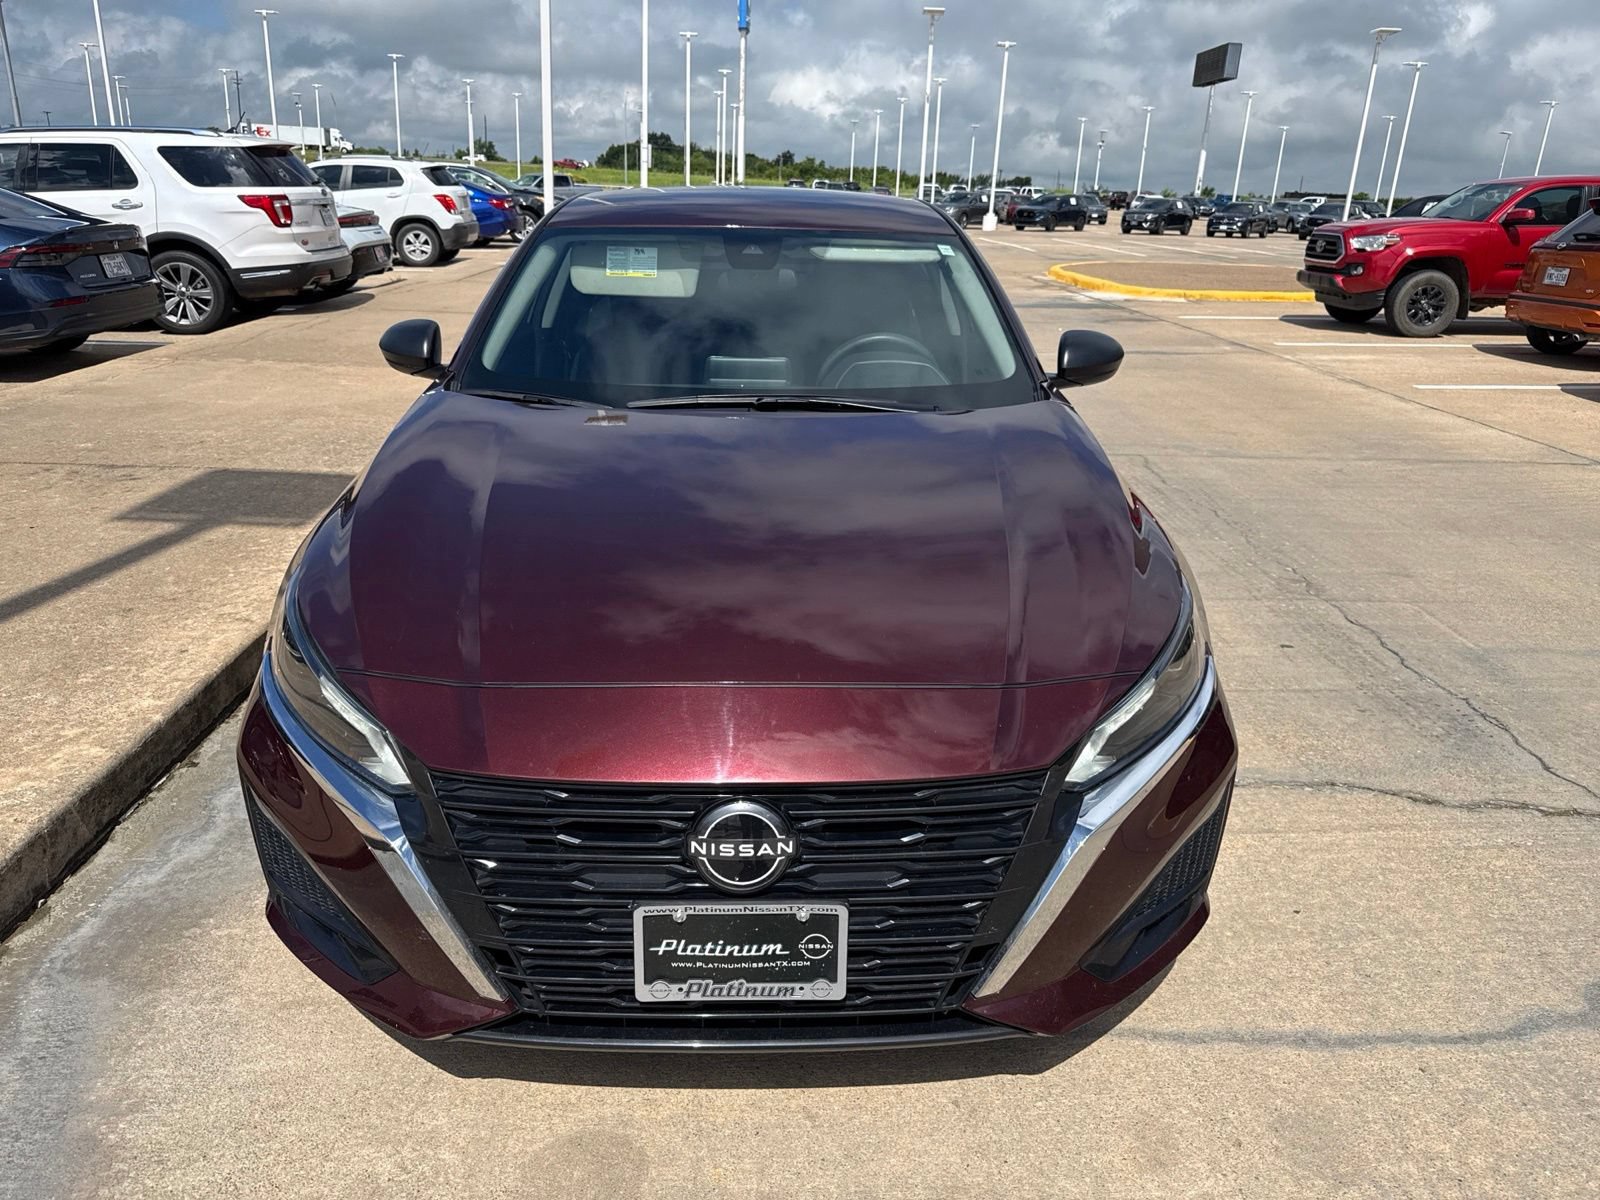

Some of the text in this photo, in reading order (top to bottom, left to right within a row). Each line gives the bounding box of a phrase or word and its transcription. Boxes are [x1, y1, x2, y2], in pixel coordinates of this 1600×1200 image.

[691, 840, 793, 857] NISSAN
[649, 939, 790, 957] Platinum
[684, 980, 805, 999] Platinum
